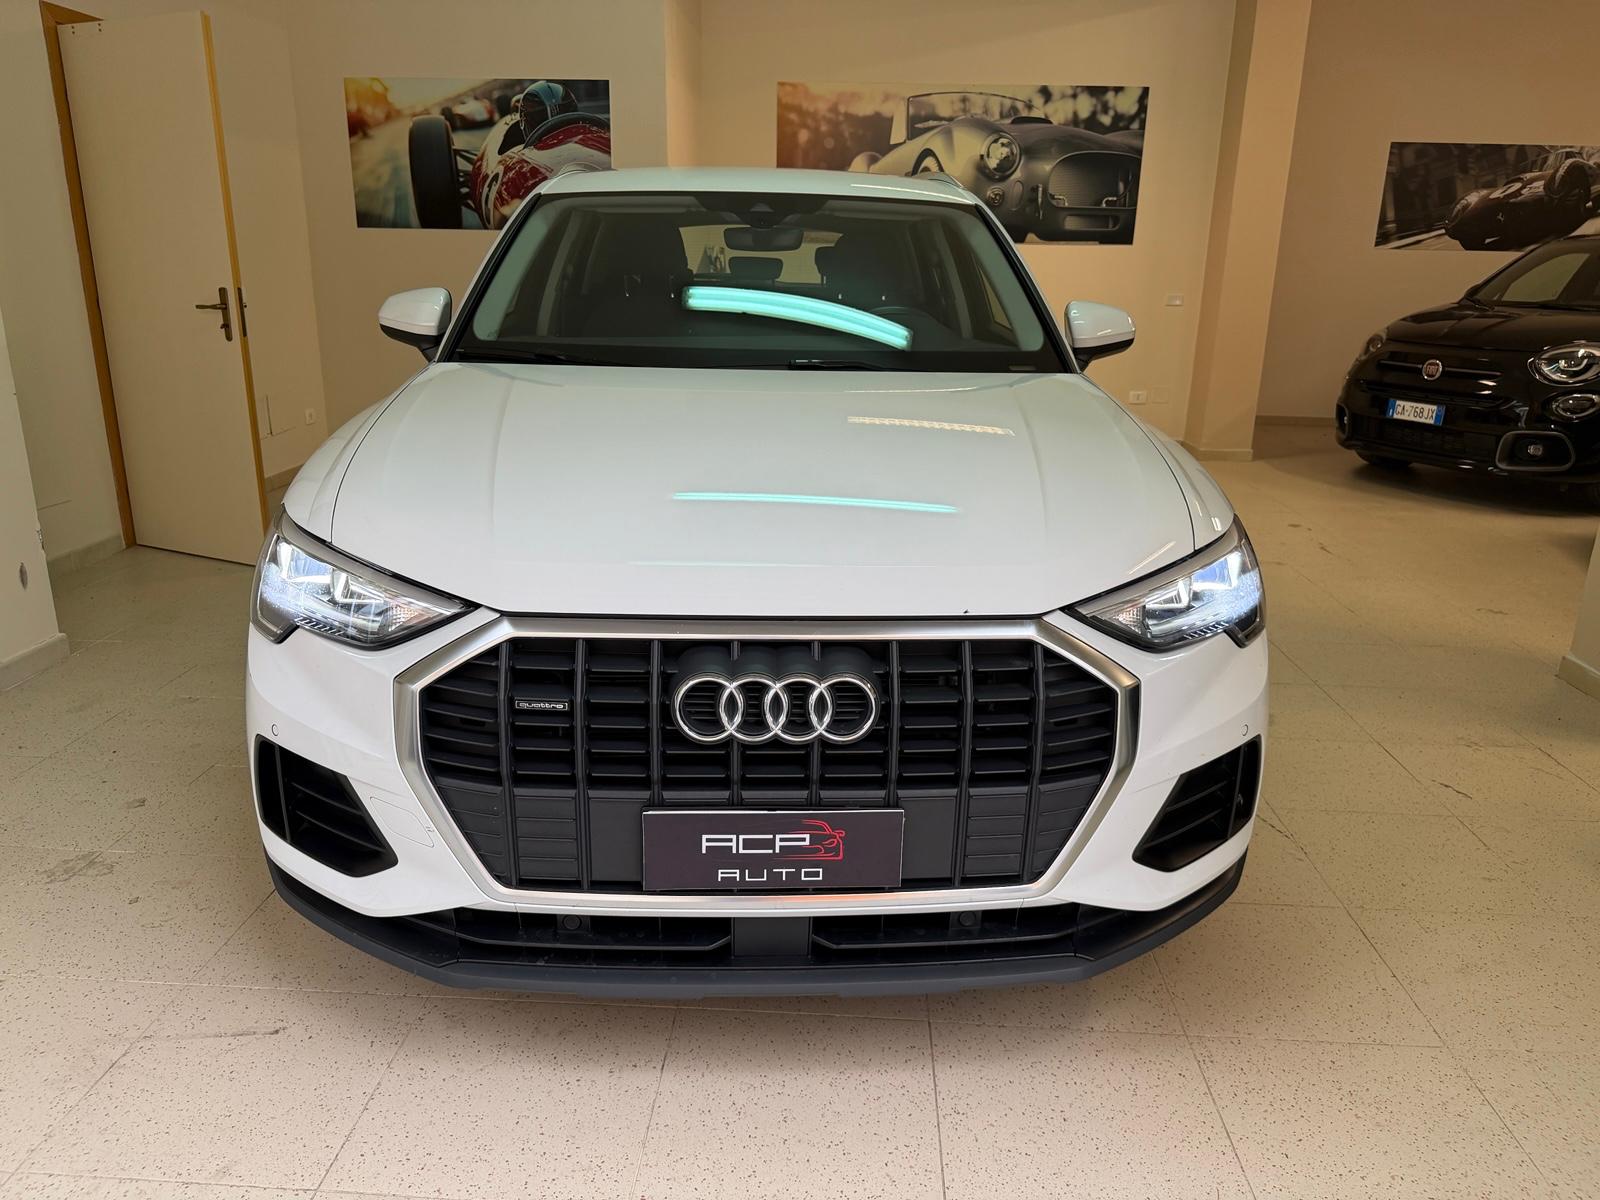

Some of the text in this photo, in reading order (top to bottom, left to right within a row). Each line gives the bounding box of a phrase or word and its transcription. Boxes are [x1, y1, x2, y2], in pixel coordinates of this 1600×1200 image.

[518, 702, 565, 710] quattro
[701, 833, 810, 854] ACP
[717, 867, 823, 882] AUTO
